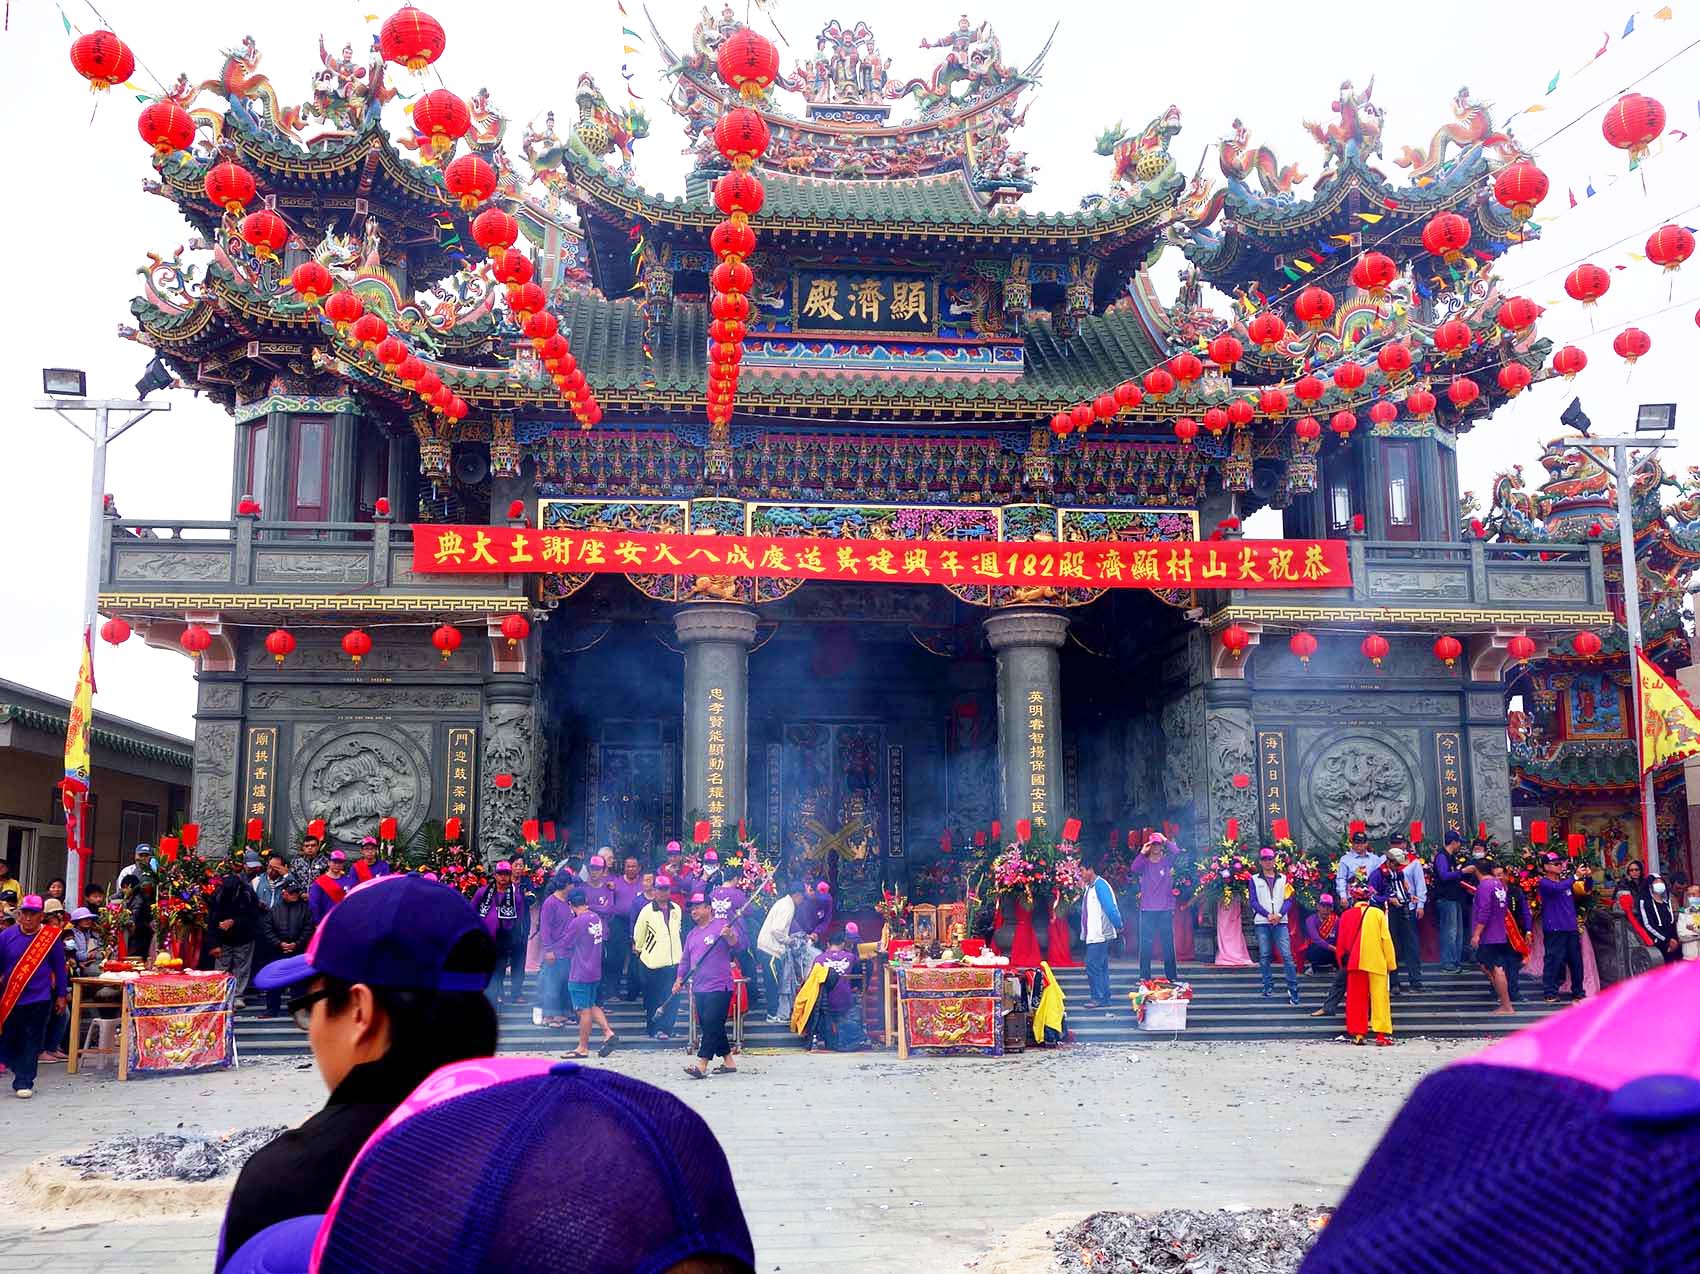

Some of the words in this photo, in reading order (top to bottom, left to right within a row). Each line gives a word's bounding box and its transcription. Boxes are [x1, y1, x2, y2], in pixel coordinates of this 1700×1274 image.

[802, 278, 928, 324] 顯濟殿
[1265, 737, 1281, 815] 海天日月共
